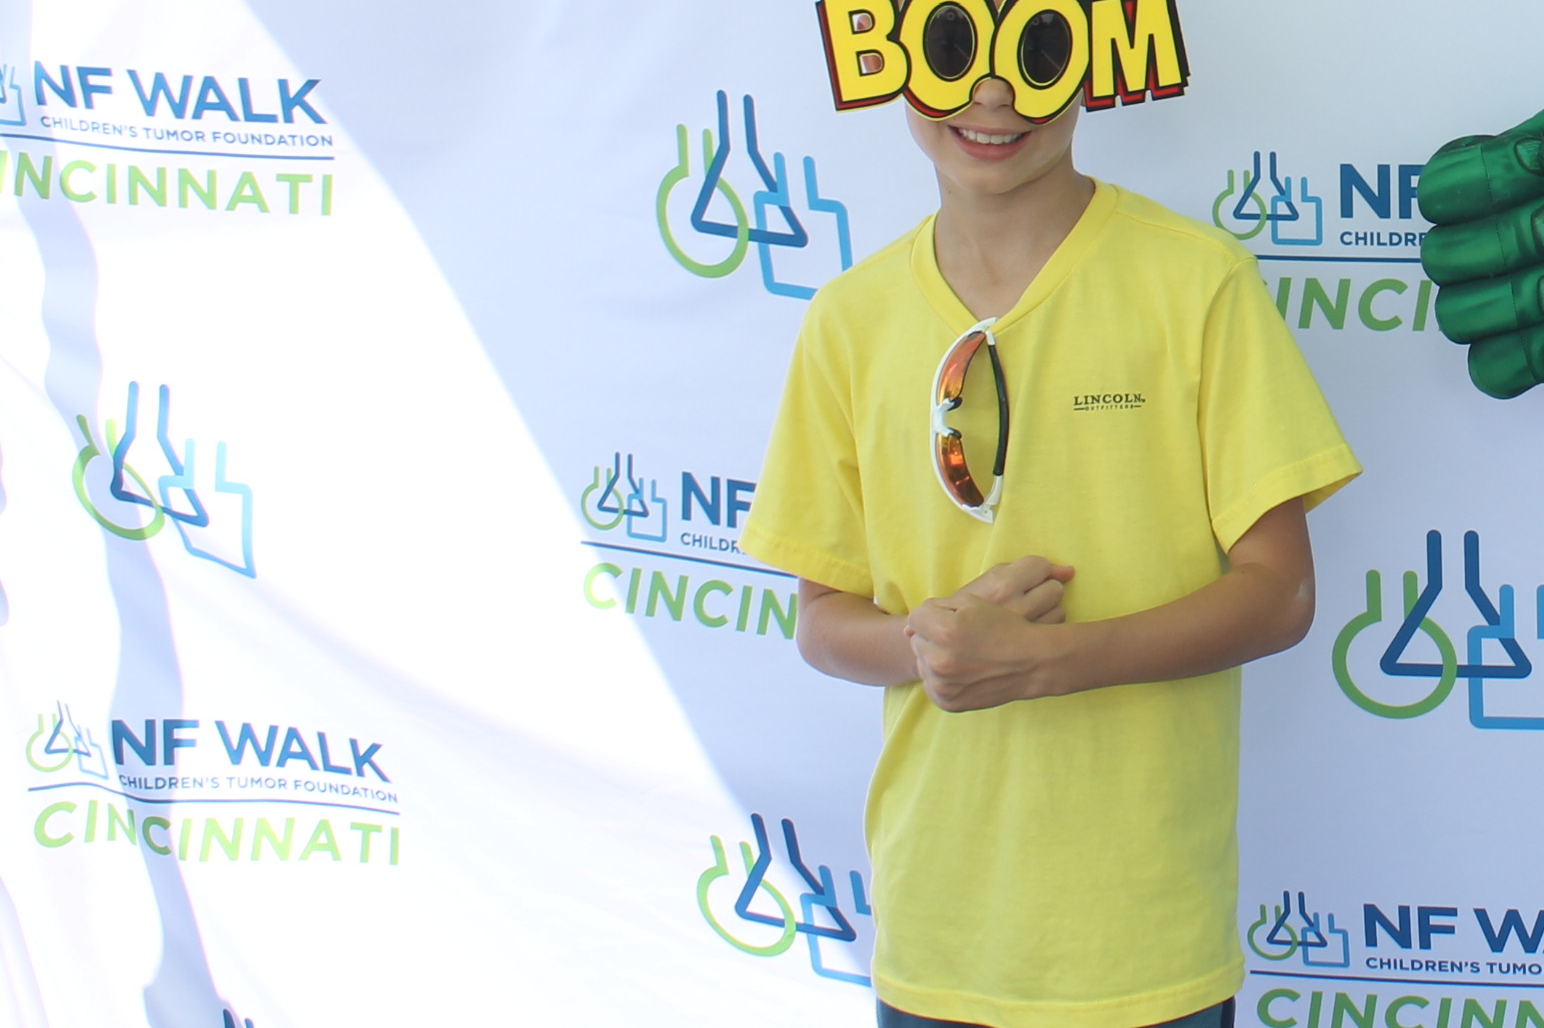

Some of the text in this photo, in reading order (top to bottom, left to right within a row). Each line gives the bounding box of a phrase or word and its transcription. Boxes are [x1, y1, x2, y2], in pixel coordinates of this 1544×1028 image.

[34, 60, 328, 125] NF WALK
[41, 116, 333, 147] CHILDREN'S TUMOR FOUNDATION
[681, 471, 757, 528] NF
[111, 719, 392, 783] NF WALK
[119, 774, 398, 804] CHILDREN'S TUMOR FOUNDATION
[33, 799, 399, 866] CINCINNATI
[1363, 903, 1458, 950] NF
[1365, 957, 1480, 974] CHILDREN'S
